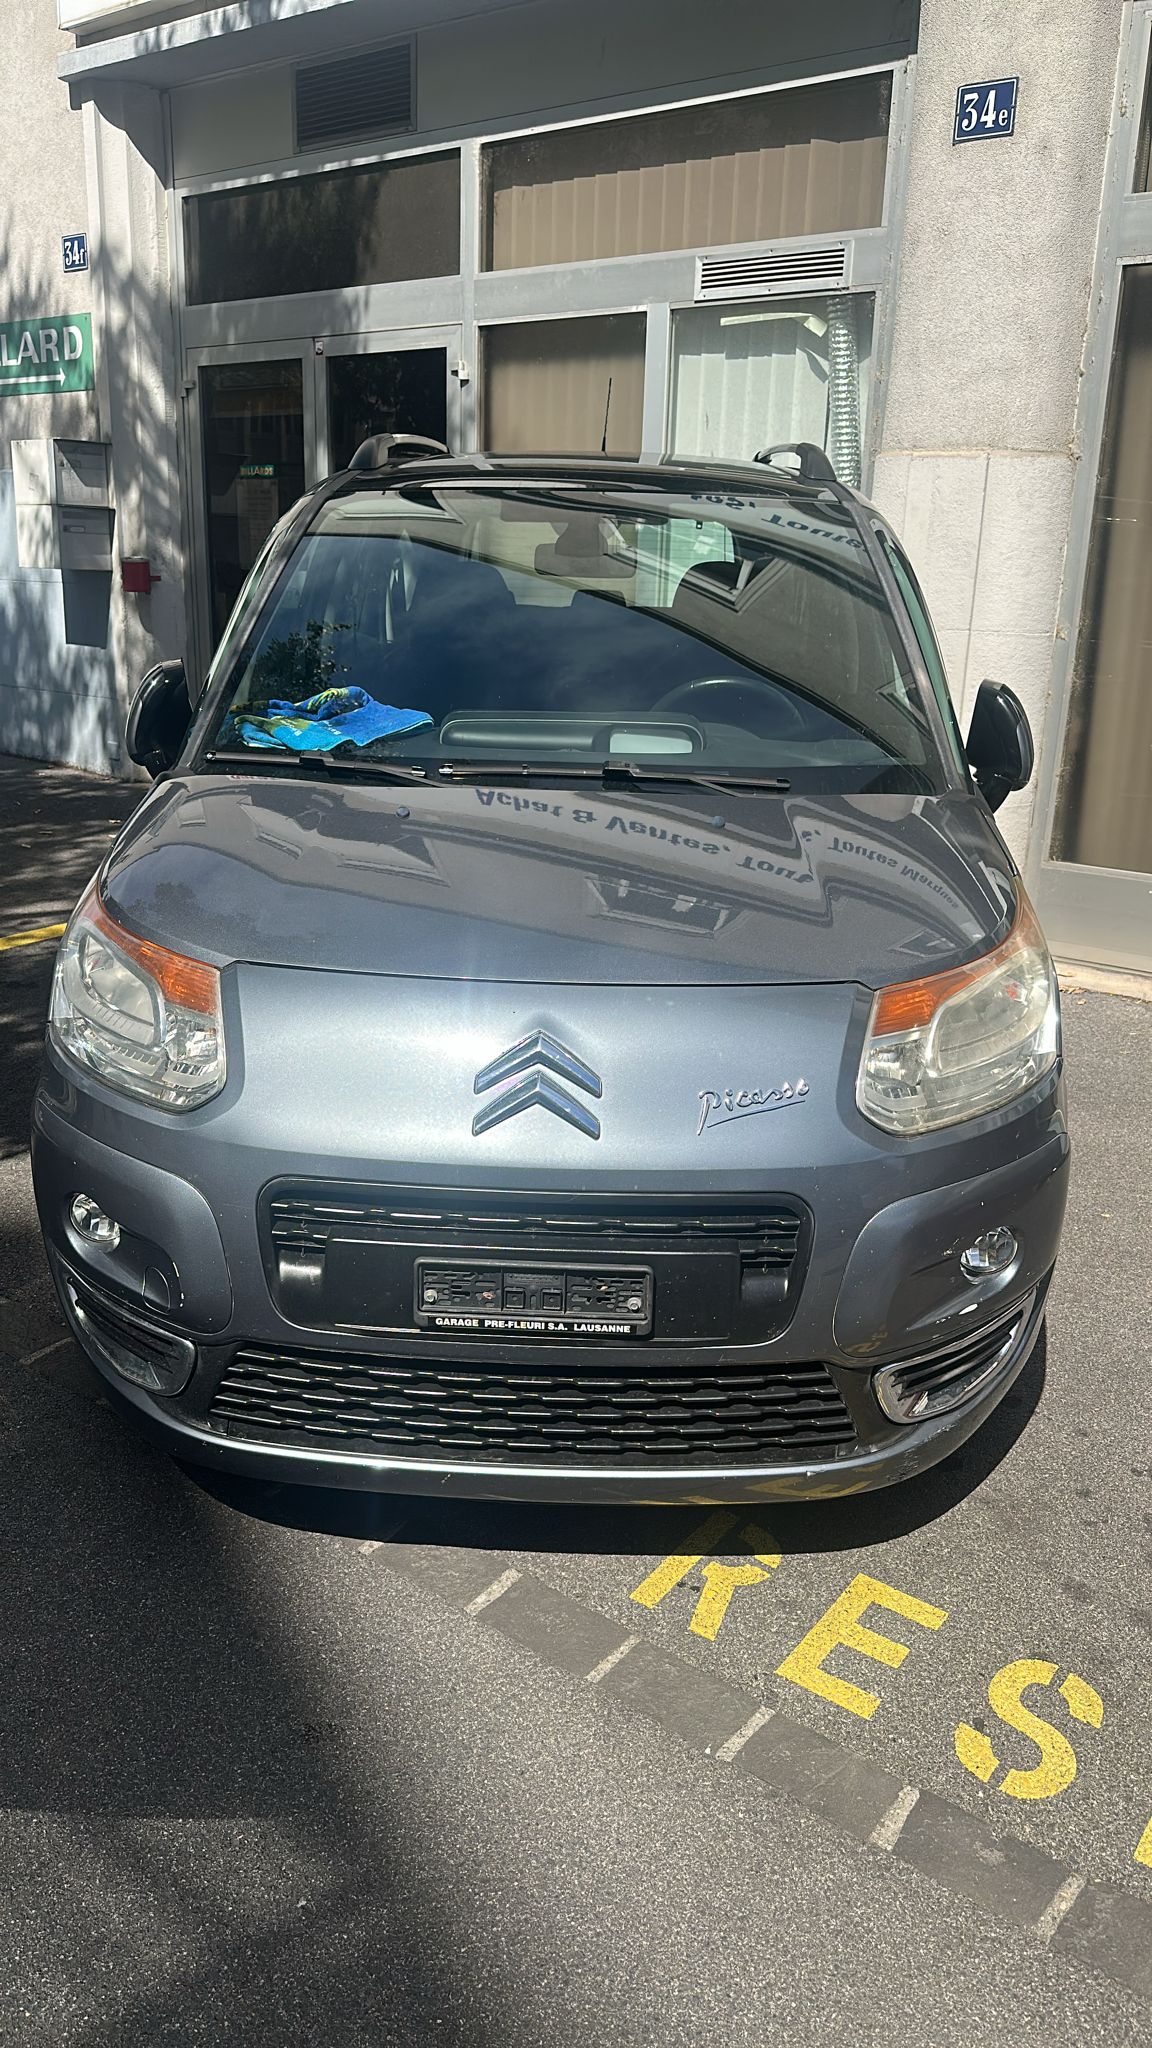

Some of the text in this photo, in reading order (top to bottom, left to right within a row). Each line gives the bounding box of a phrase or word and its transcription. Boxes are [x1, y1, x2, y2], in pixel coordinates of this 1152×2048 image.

[961, 89, 1009, 132] 34e
[64, 240, 85, 266] 34f
[0, 325, 83, 367] LARD
[435, 1317, 631, 1333] GARAGE PRE-FLEURI S.A. LAUSANNE
[630, 1511, 1152, 1867] RES
